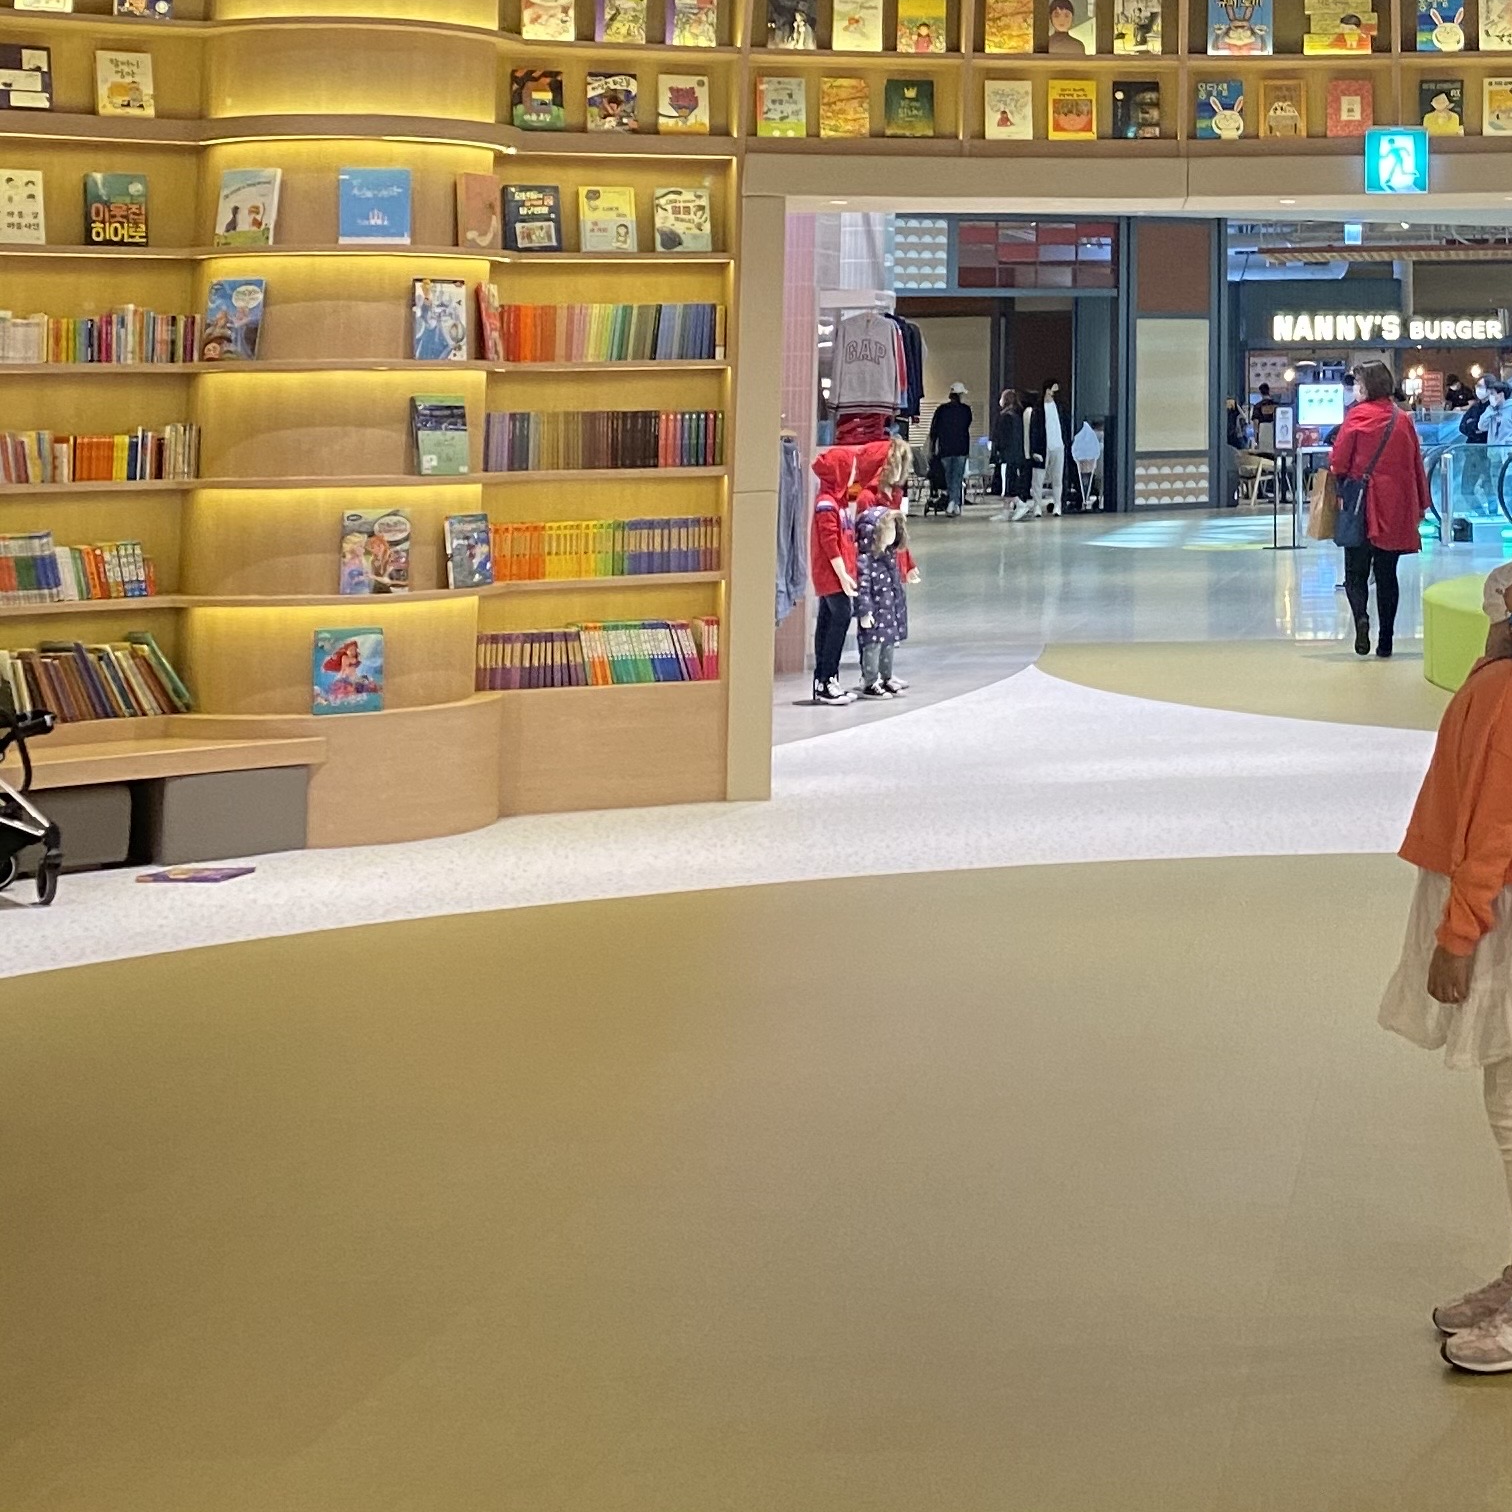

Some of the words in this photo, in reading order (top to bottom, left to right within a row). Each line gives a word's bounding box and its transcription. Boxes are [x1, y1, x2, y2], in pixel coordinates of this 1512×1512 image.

[90, 203, 146, 225] 이웃집
[91, 222, 148, 243] 히어로
[1273, 314, 1400, 341] NANNY'S
[1409, 320, 1503, 340] BURGER
[844, 339, 888, 364] GAP
